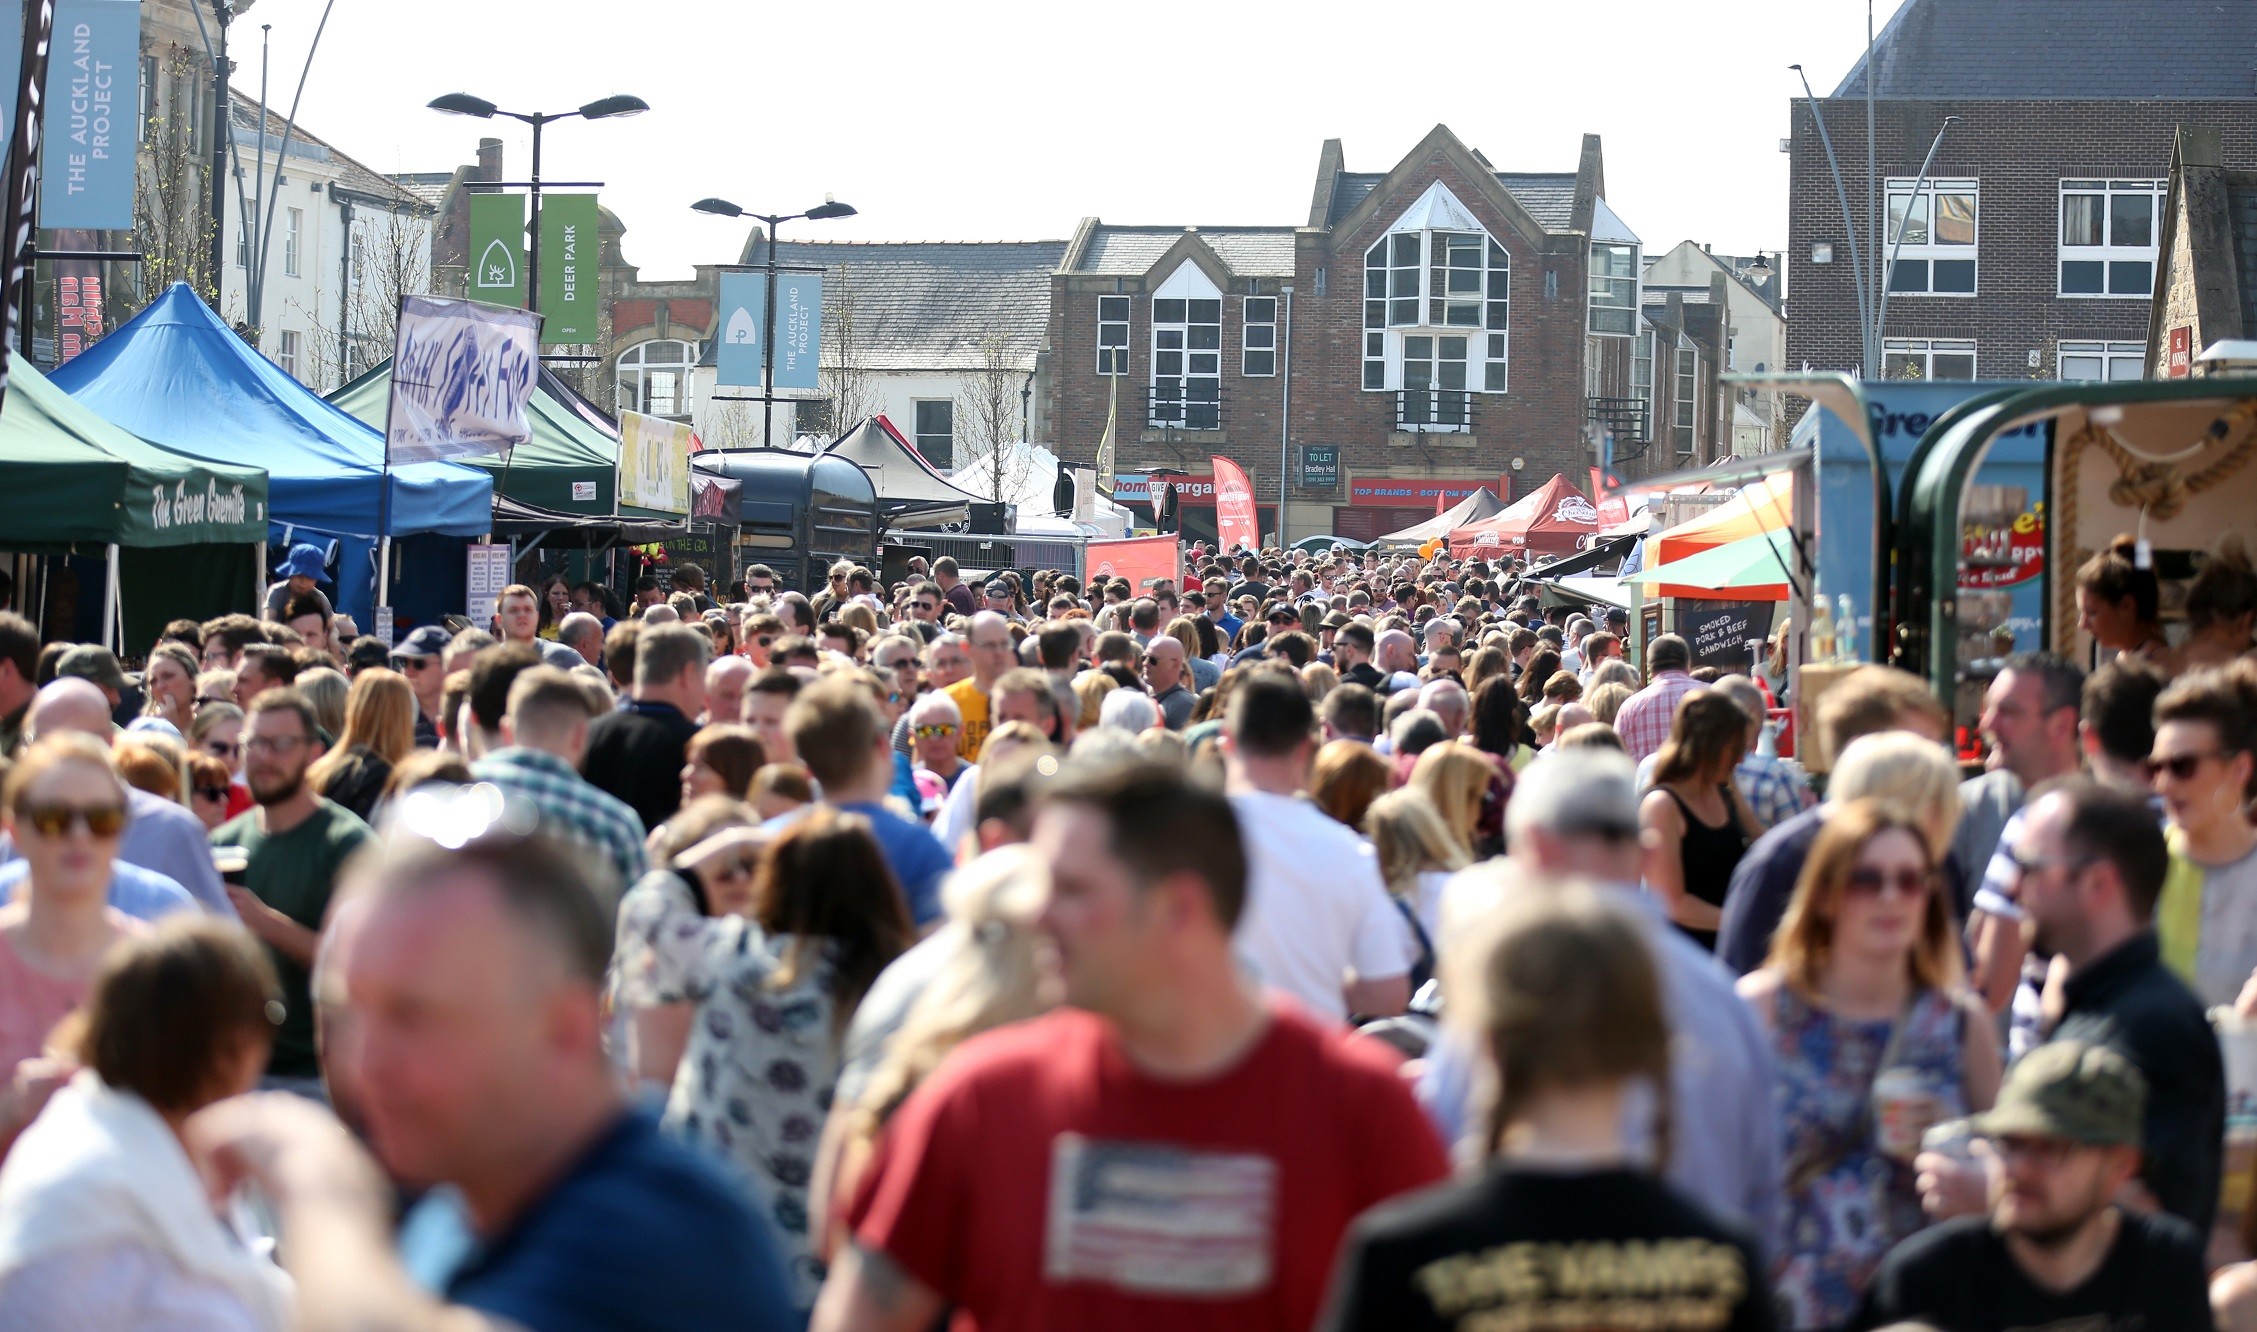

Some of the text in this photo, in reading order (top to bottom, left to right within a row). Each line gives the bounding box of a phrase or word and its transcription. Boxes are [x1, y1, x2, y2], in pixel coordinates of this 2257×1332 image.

[68, 23, 91, 195] THE AUCKLAND
[92, 60, 112, 159] PROJECT
[564, 225, 575, 300] DEER PARK
[787, 287, 798, 371] THE AUCKLAND
[799, 305, 808, 354] PROJECT
[1309, 453, 1332, 462] TO LET
[1305, 465, 1336, 475] Bradley Hall
[1113, 479, 1149, 493] hom
[1151, 483, 1164, 492] GIVE
[1353, 488, 1372, 496] TOP
[1374, 489, 1412, 497] BRANDS
[1420, 489, 1459, 497] BOTOM
[152, 476, 245, 529] The Green Guerrilla
[676, 538, 692, 551] THE
[1695, 631, 1716, 645] PORK
[1726, 619, 1748, 634] BEEF
[1699, 615, 1731, 633] SMOKED
[1699, 634, 1743, 657] SANDWICH
